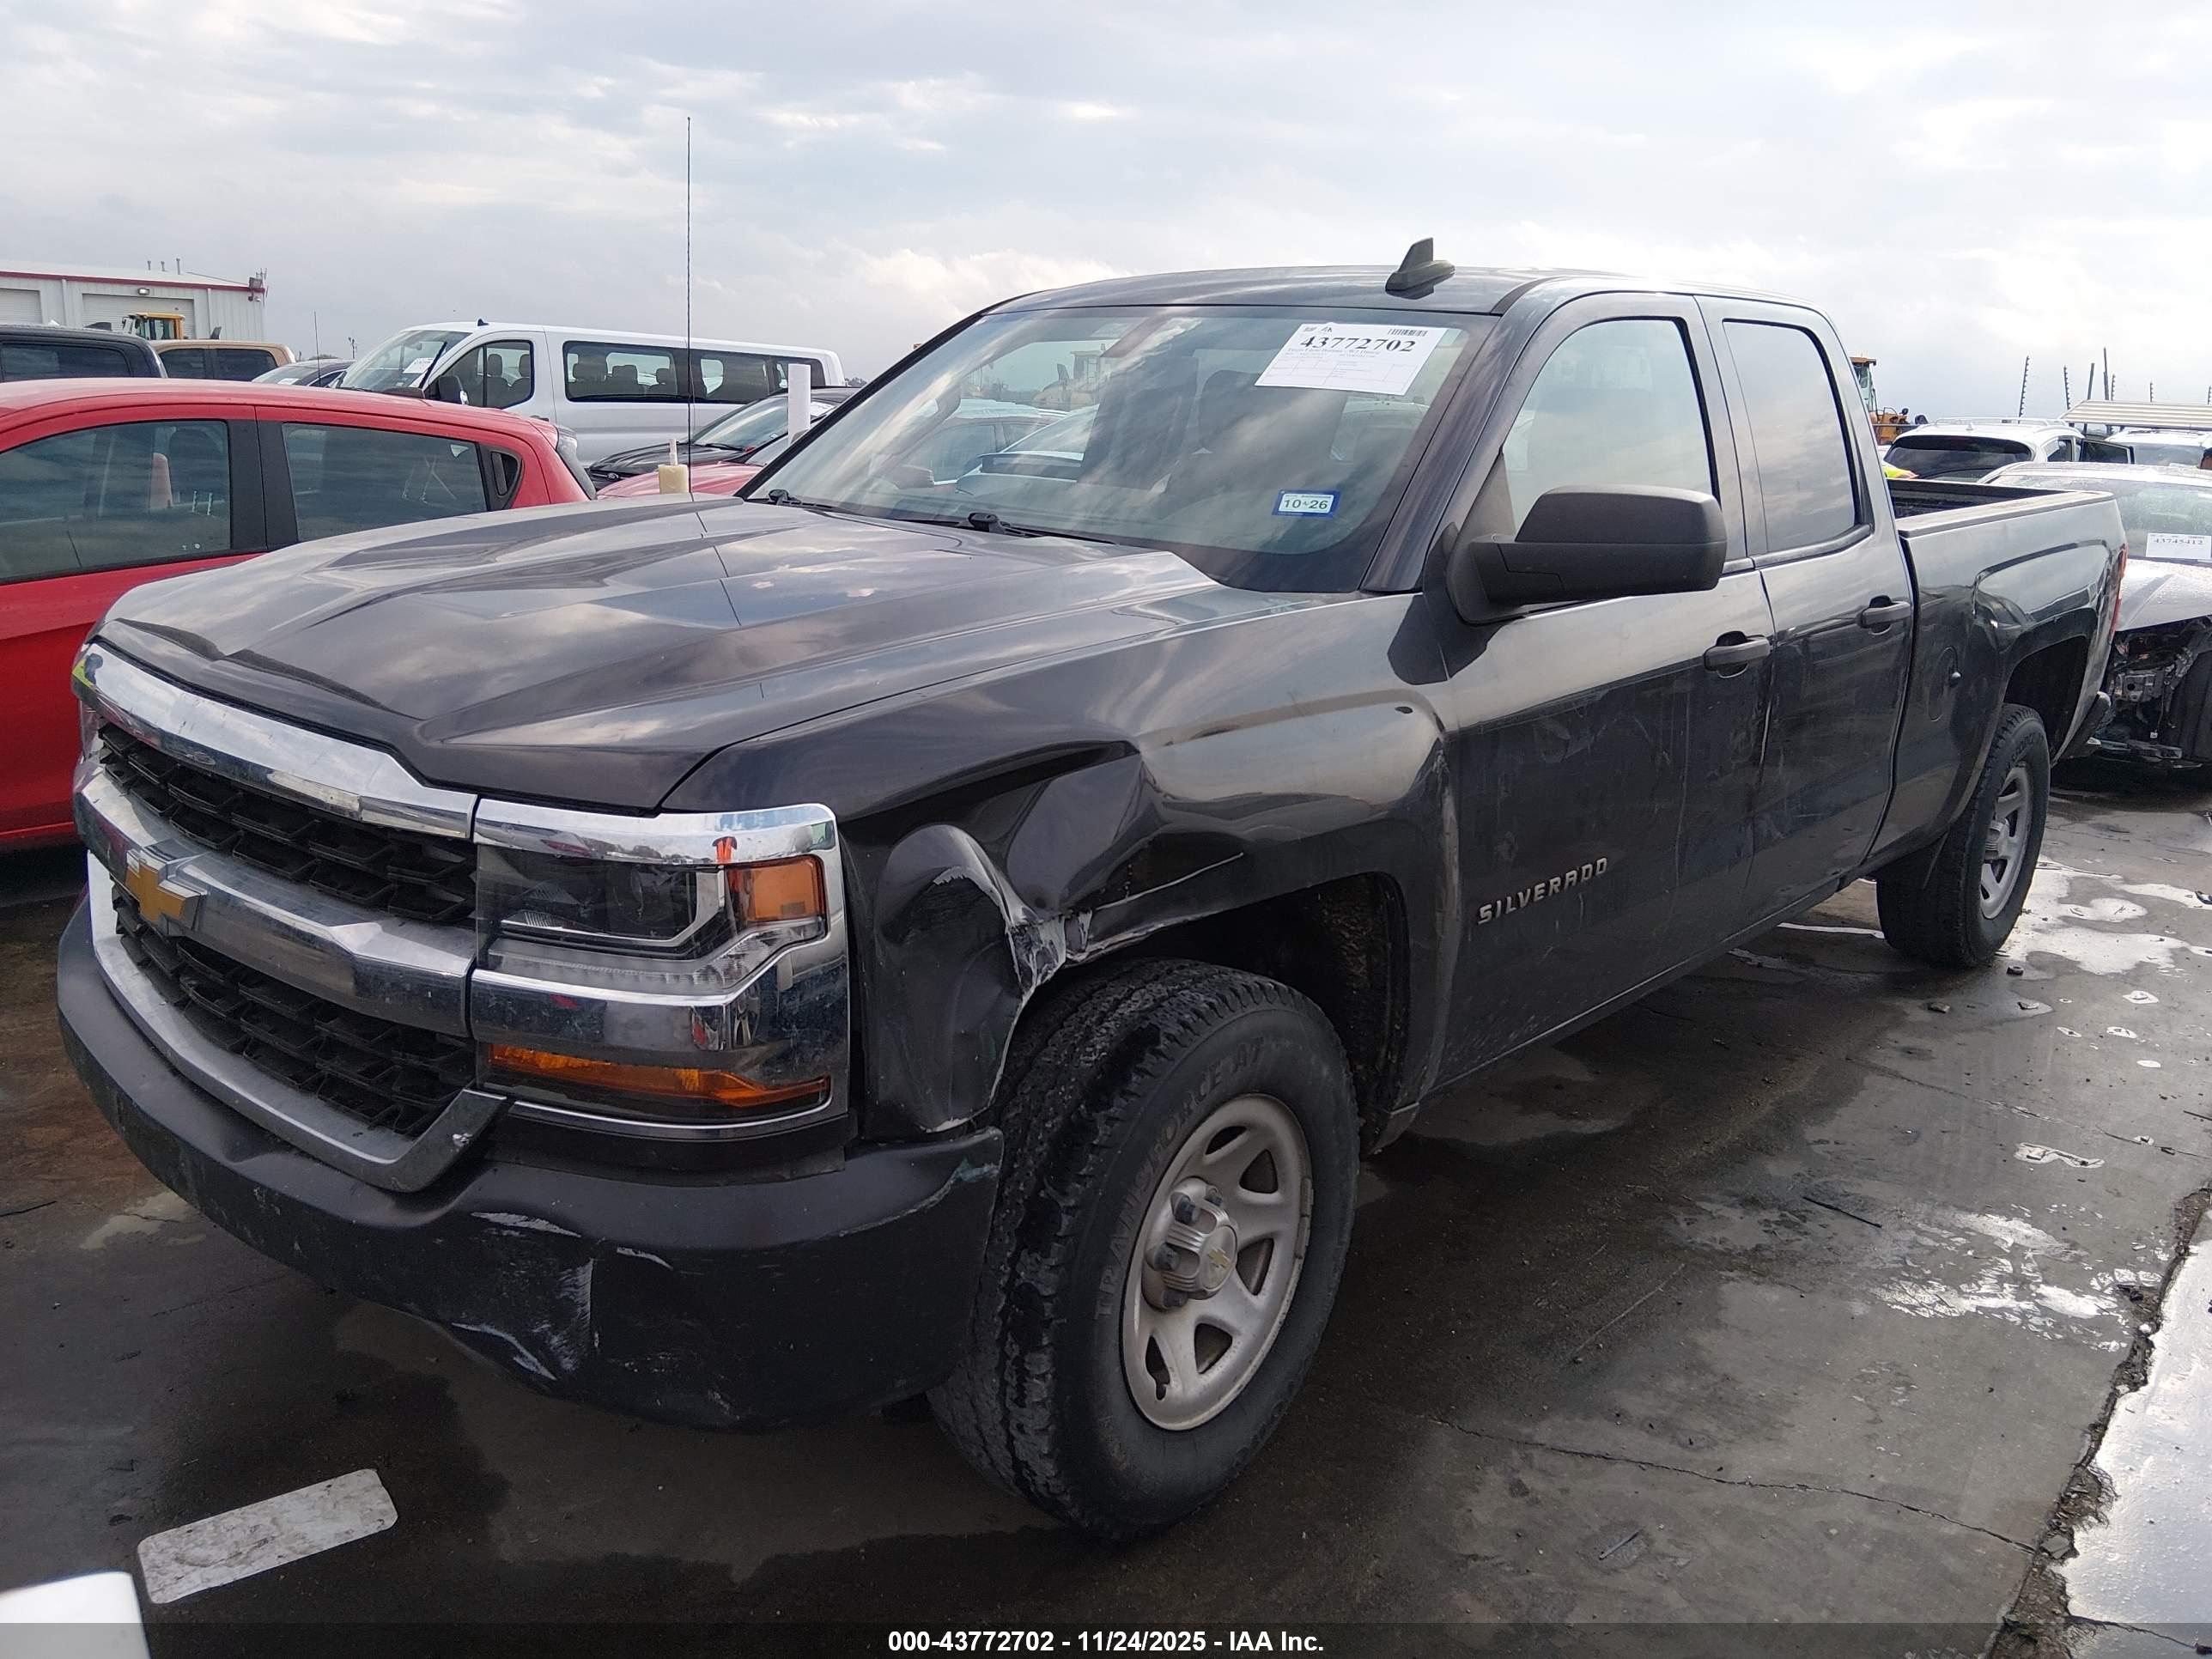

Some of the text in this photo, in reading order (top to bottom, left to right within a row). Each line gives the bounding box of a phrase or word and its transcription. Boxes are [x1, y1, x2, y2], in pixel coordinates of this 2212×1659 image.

[1300, 335, 1415, 352] 43772702
[1285, 499, 1328, 510] 10 26
[1477, 857, 1607, 925] SILVERADO
